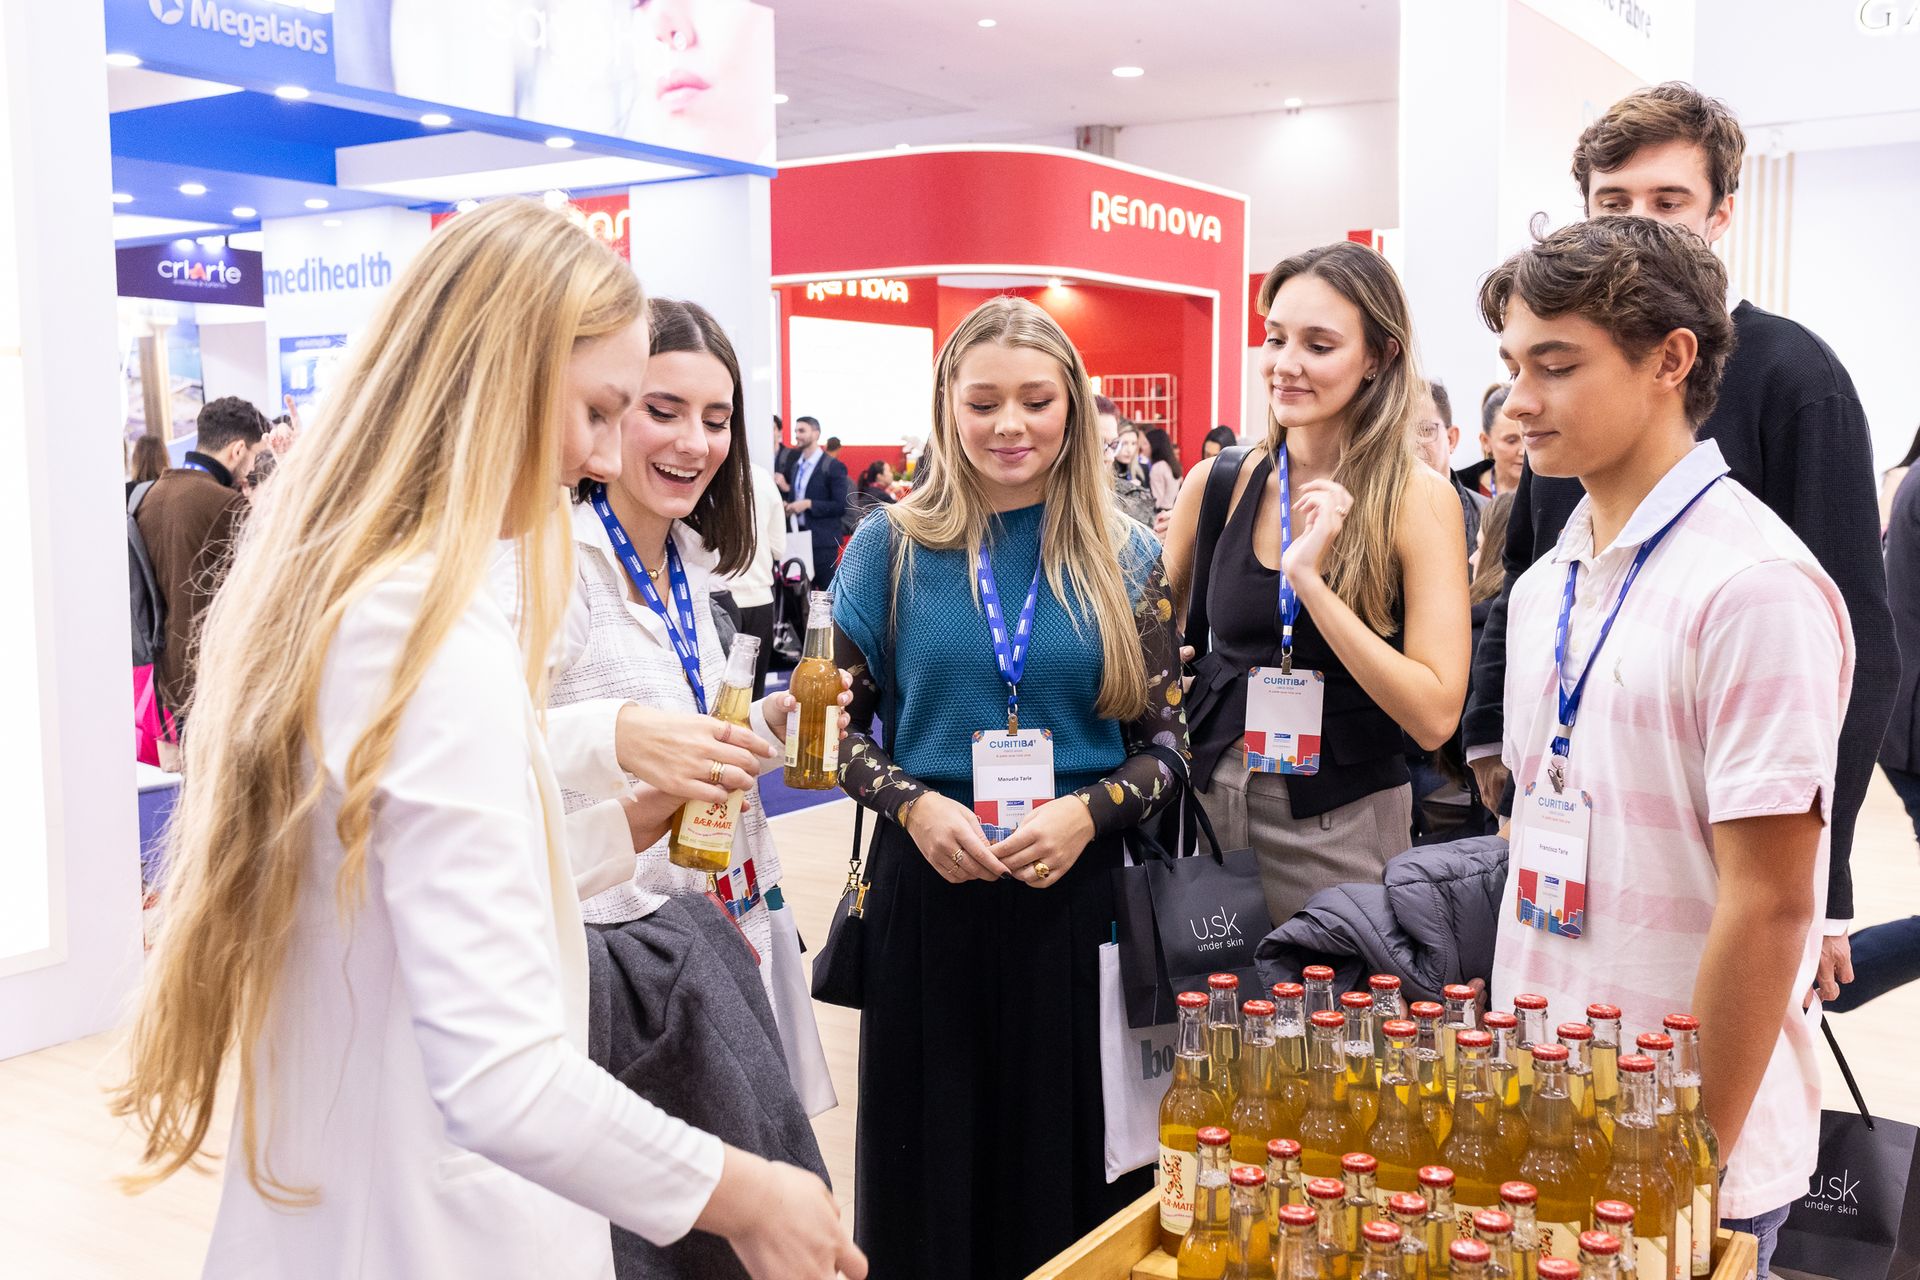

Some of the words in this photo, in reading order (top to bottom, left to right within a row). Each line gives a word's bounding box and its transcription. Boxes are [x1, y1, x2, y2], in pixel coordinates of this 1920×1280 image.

[190, 0, 328, 55] Megalabs
[1091, 190, 1221, 243] RENNOVA
[263, 251, 392, 295] medihealth
[1197, 941, 1223, 952] under
[1226, 938, 1244, 948] skin
[1804, 1200, 1834, 1212] under
[1837, 1204, 1858, 1215] skin
